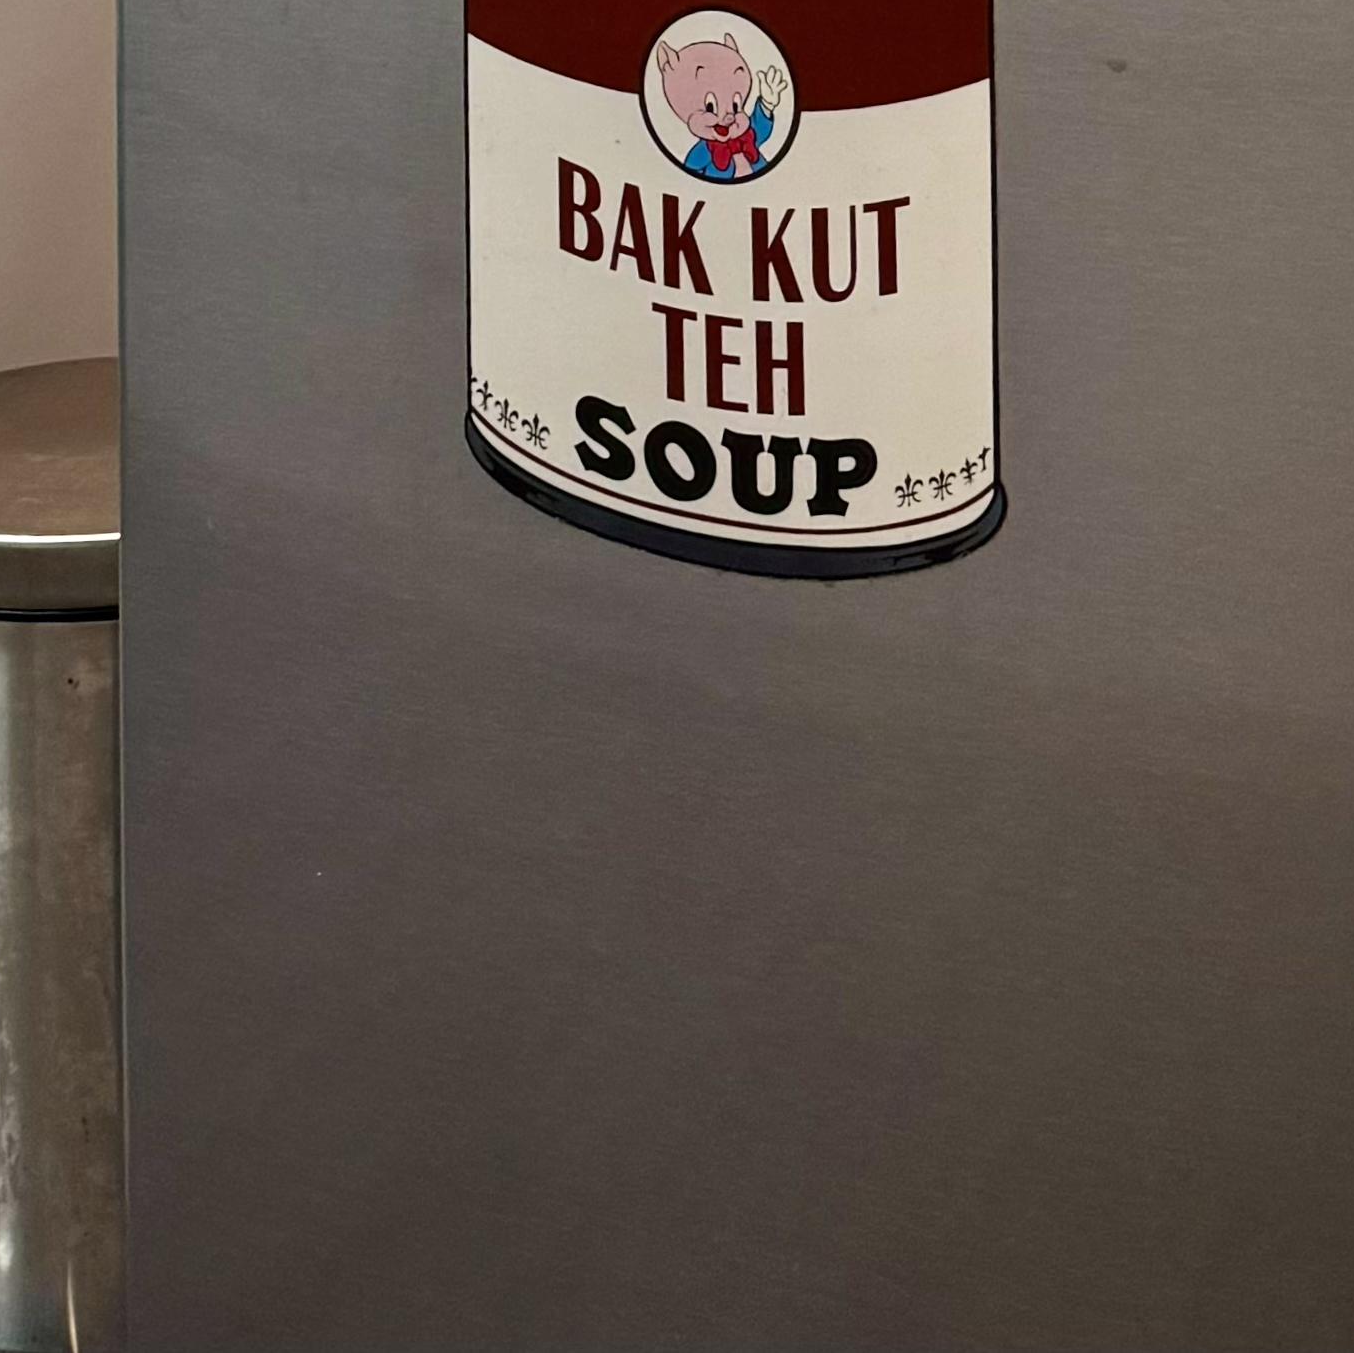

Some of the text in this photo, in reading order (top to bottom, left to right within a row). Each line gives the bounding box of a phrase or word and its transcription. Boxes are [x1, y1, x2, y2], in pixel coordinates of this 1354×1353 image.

[558, 156, 911, 303] BAK KUT
[651, 302, 806, 416] TEH
[574, 395, 879, 517] SOUP
